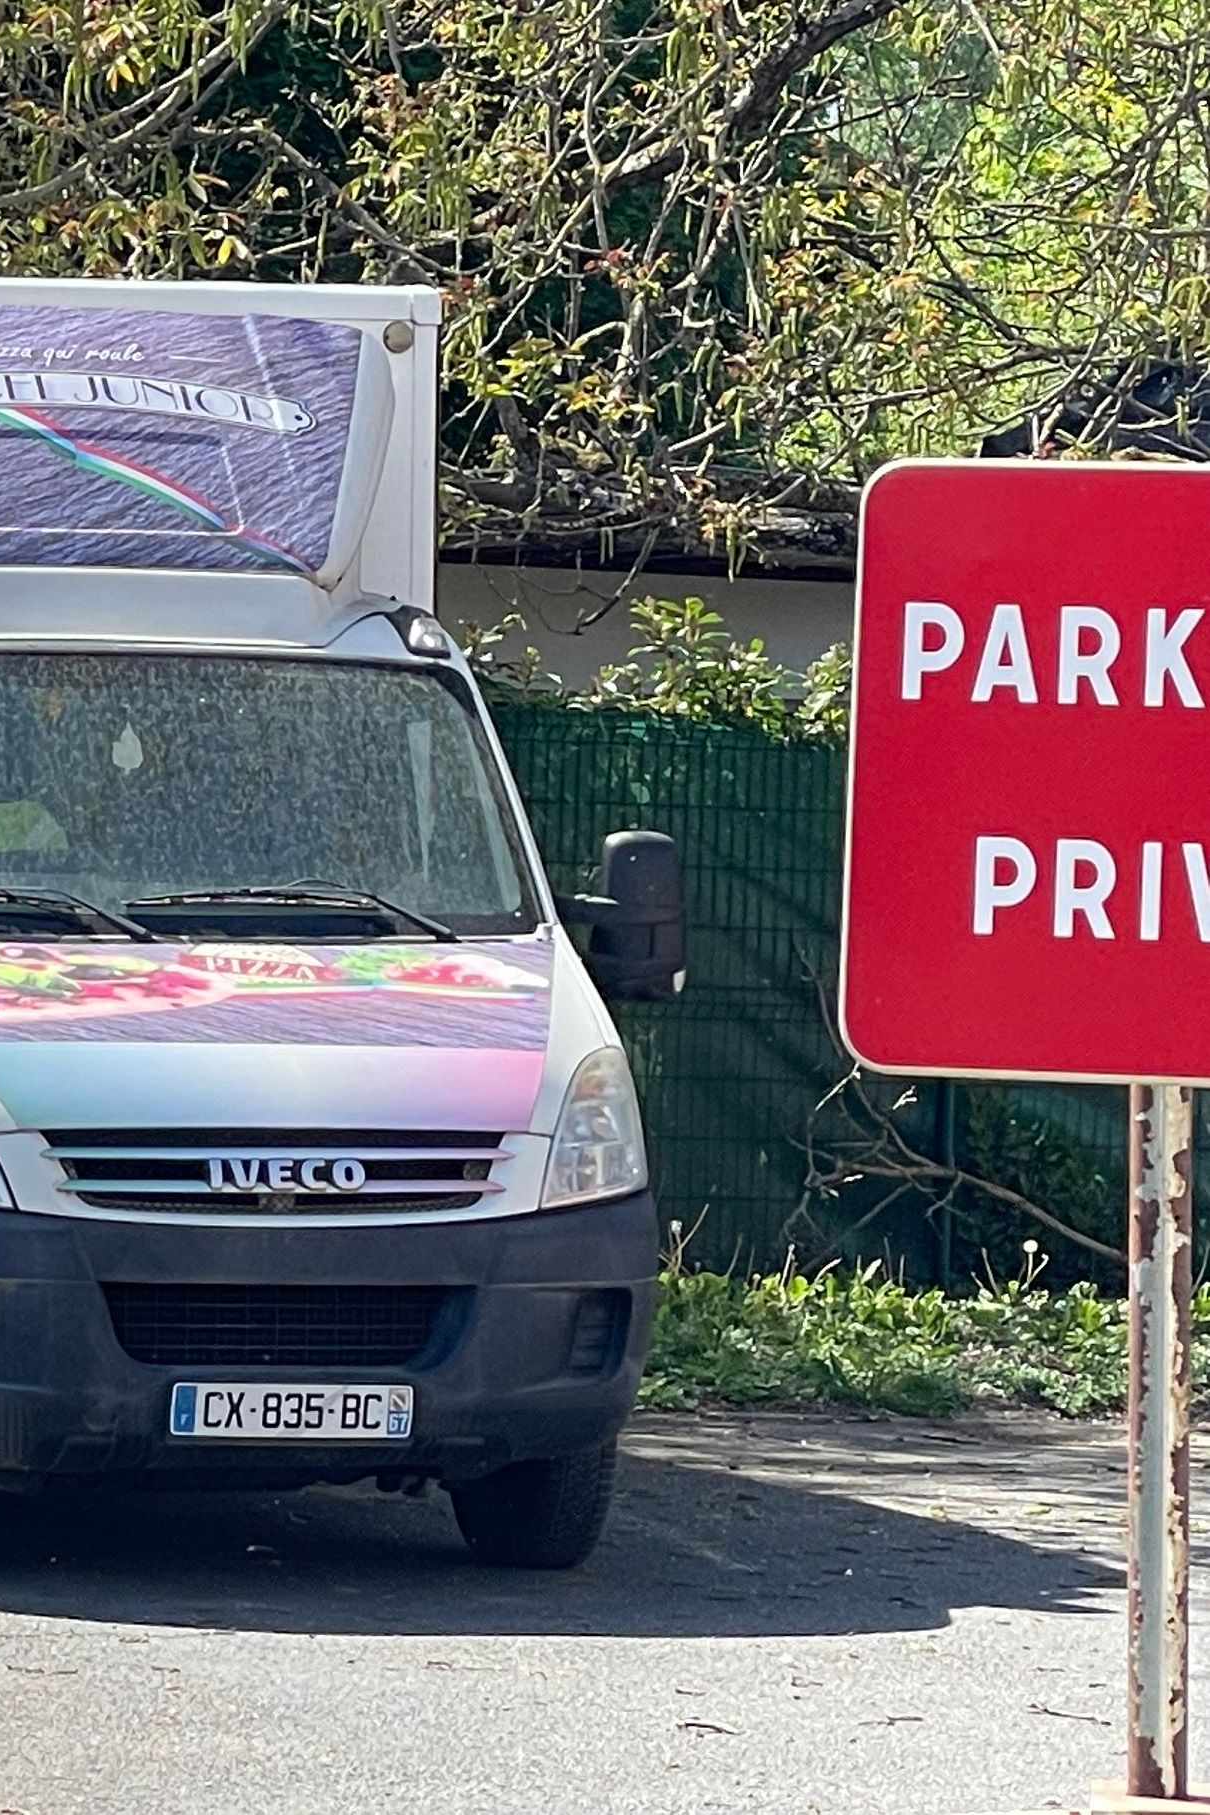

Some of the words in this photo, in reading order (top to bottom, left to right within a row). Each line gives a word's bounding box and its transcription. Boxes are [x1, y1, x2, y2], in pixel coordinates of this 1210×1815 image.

[43, 344, 77, 367] qui
[85, 343, 145, 362] roule
[74, 376, 277, 427] JUNIOR
[901, 602, 1206, 708] PARK
[205, 956, 317, 981] PIZZA
[208, 1158, 366, 1191] IVECO
[203, 1391, 382, 1429] CX-835-BC
[389, 1413, 407, 1432] 67
